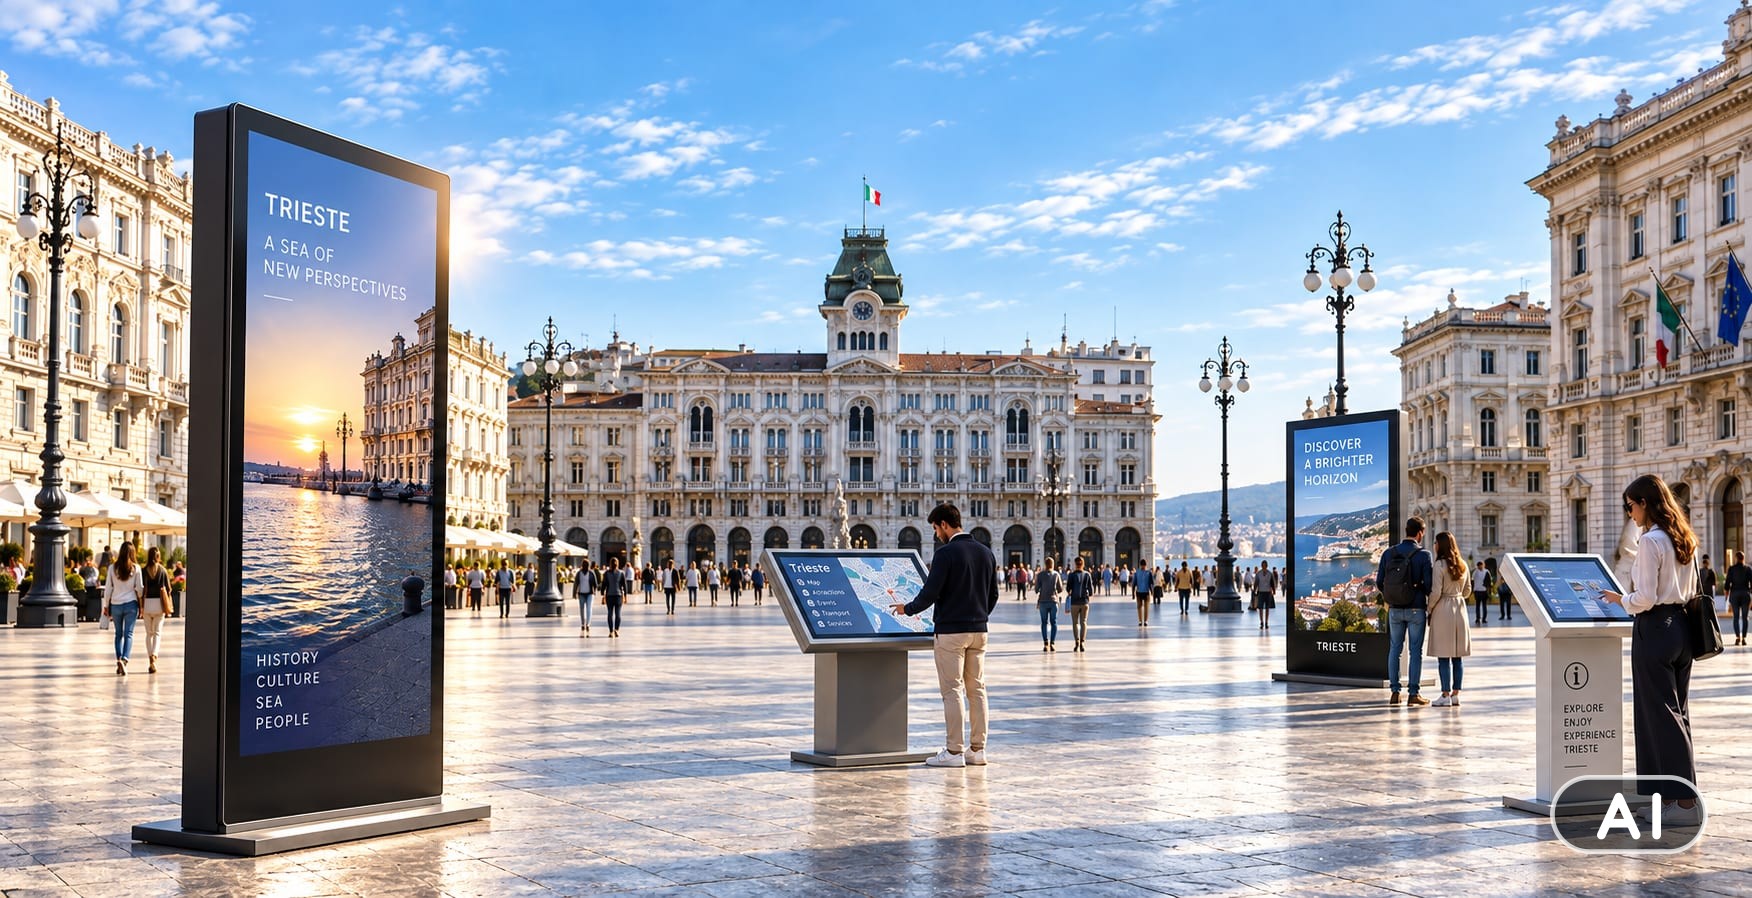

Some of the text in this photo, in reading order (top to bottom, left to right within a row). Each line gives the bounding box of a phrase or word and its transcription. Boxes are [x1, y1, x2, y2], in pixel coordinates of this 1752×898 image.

[265, 192, 350, 233] TRIESTE
[264, 235, 334, 263] A SEA OF
[264, 259, 407, 301] NEW PERSPECTIVES
[1304, 438, 1362, 453] DISCOVER
[1304, 454, 1373, 470] A BRIGHTER
[1304, 472, 1358, 486] HORIZON
[788, 563, 831, 573] Trieste
[1316, 641, 1357, 653] TRIESTE
[256, 651, 319, 667] HISTORY
[256, 671, 320, 688] CULTURE
[256, 695, 283, 709] SEA
[1564, 703, 1604, 713] EXPLORE
[255, 712, 310, 730] PEOPLE
[1564, 717, 1592, 727] ENJOY
[1564, 729, 1616, 741] EXPERIENCE
[1564, 744, 1599, 754] TRIESTE
